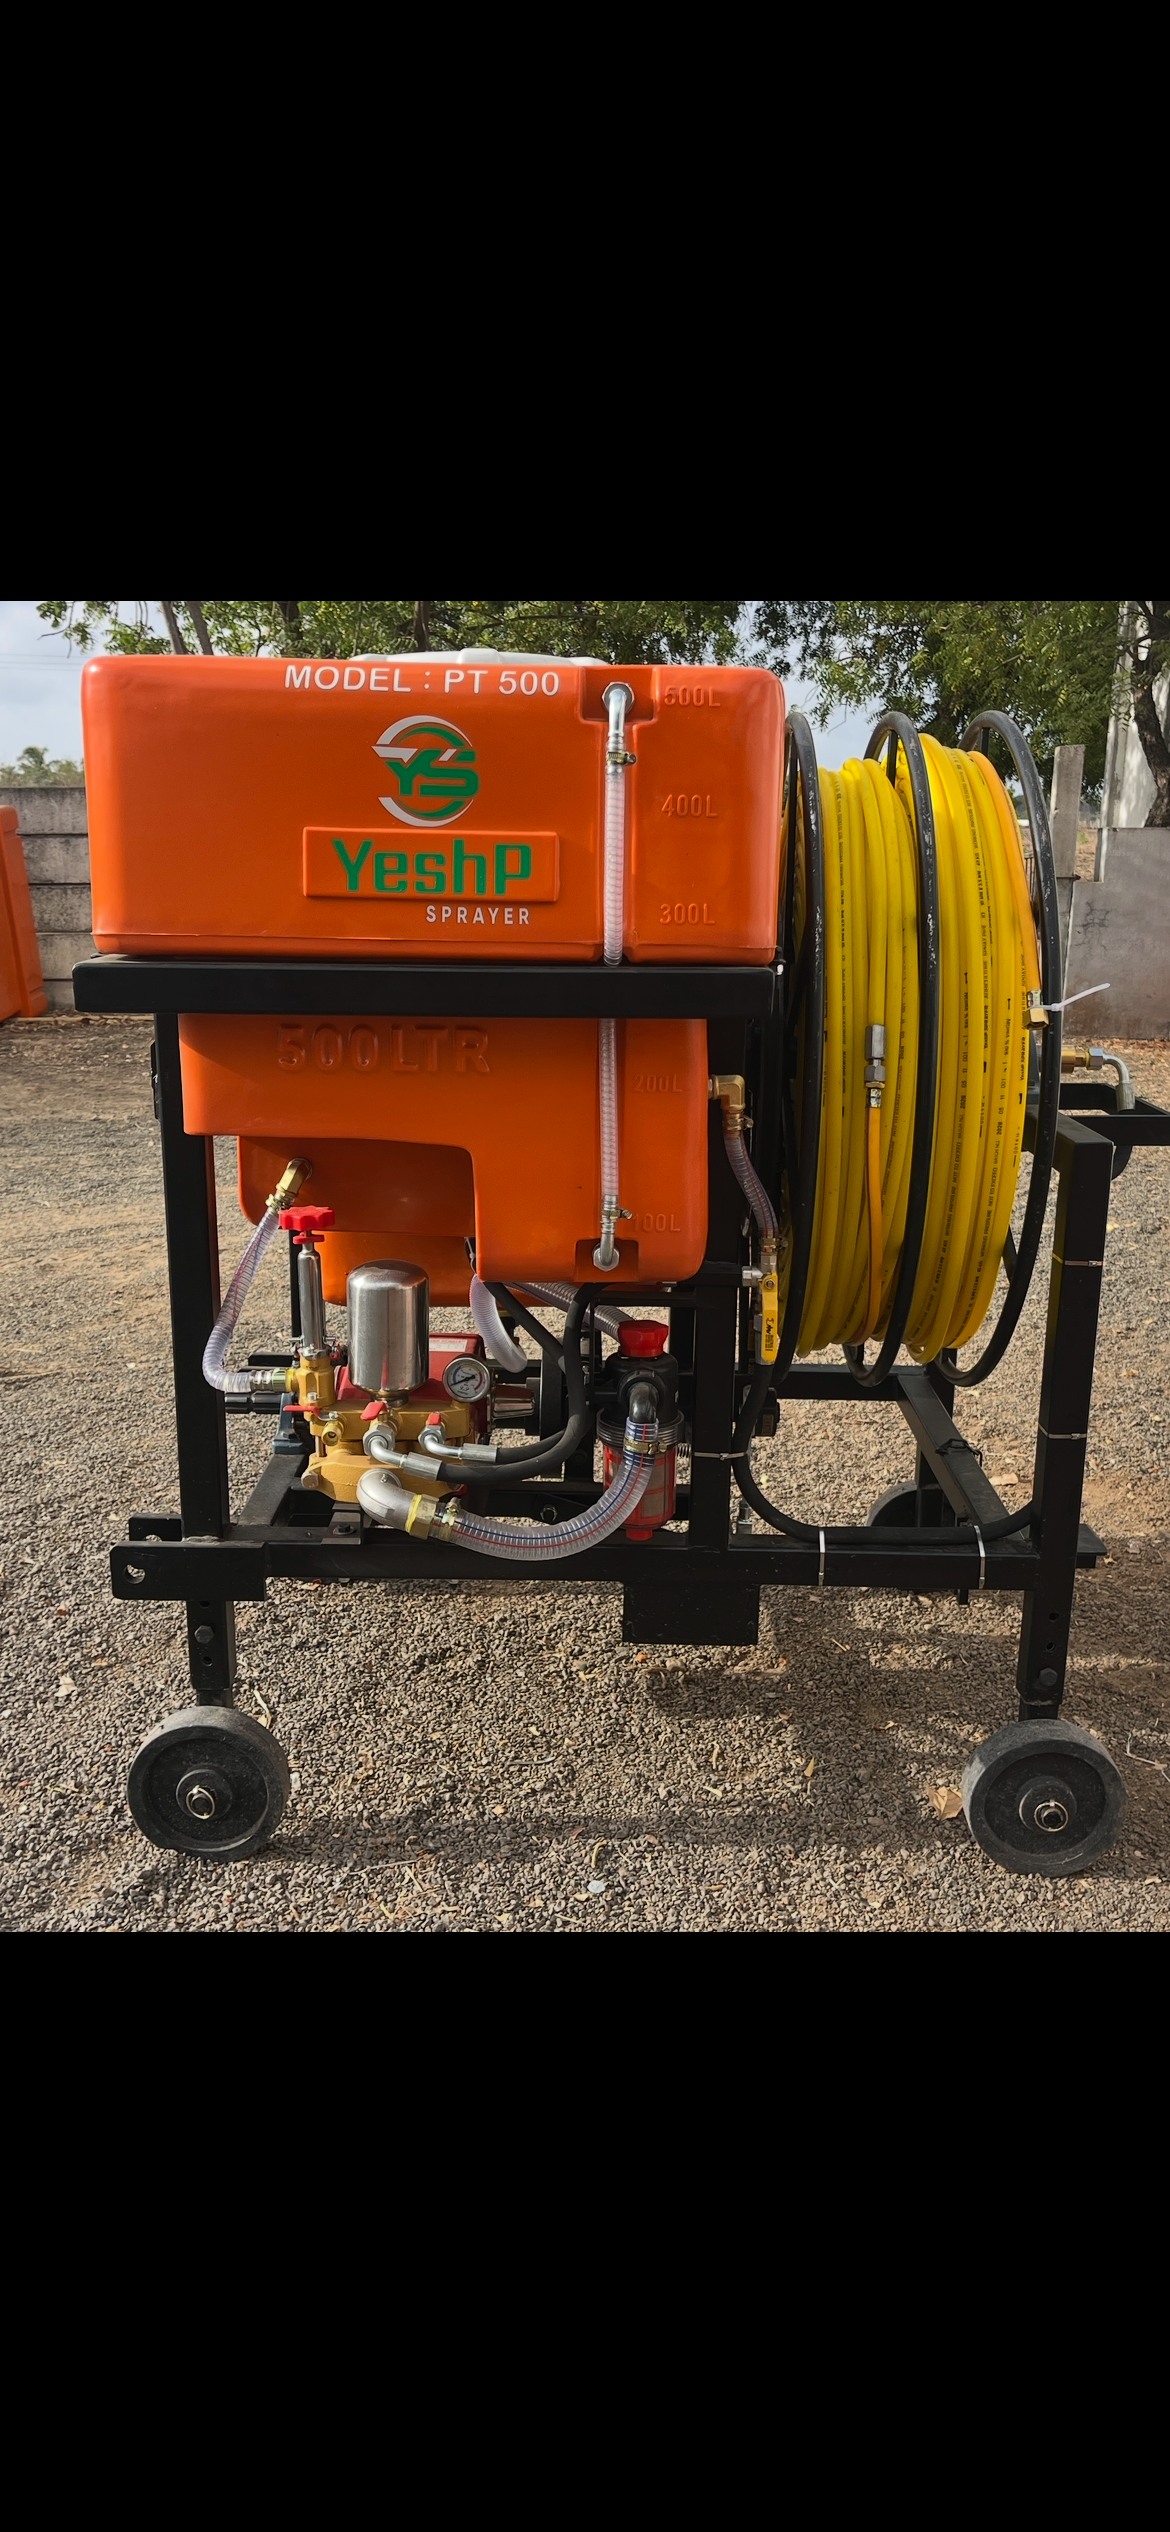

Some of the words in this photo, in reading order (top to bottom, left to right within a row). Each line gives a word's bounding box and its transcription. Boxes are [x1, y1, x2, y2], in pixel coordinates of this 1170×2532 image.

[284, 665, 412, 693] MODEL
[444, 670, 488, 694] PT
[498, 671, 560, 696] 500
[664, 685, 721, 707] 500L
[661, 794, 718, 818] 400L
[331, 838, 532, 896] YeshP
[425, 904, 530, 925] SPRAYER
[659, 903, 716, 925] 300L
[631, 1074, 683, 1093] 200L
